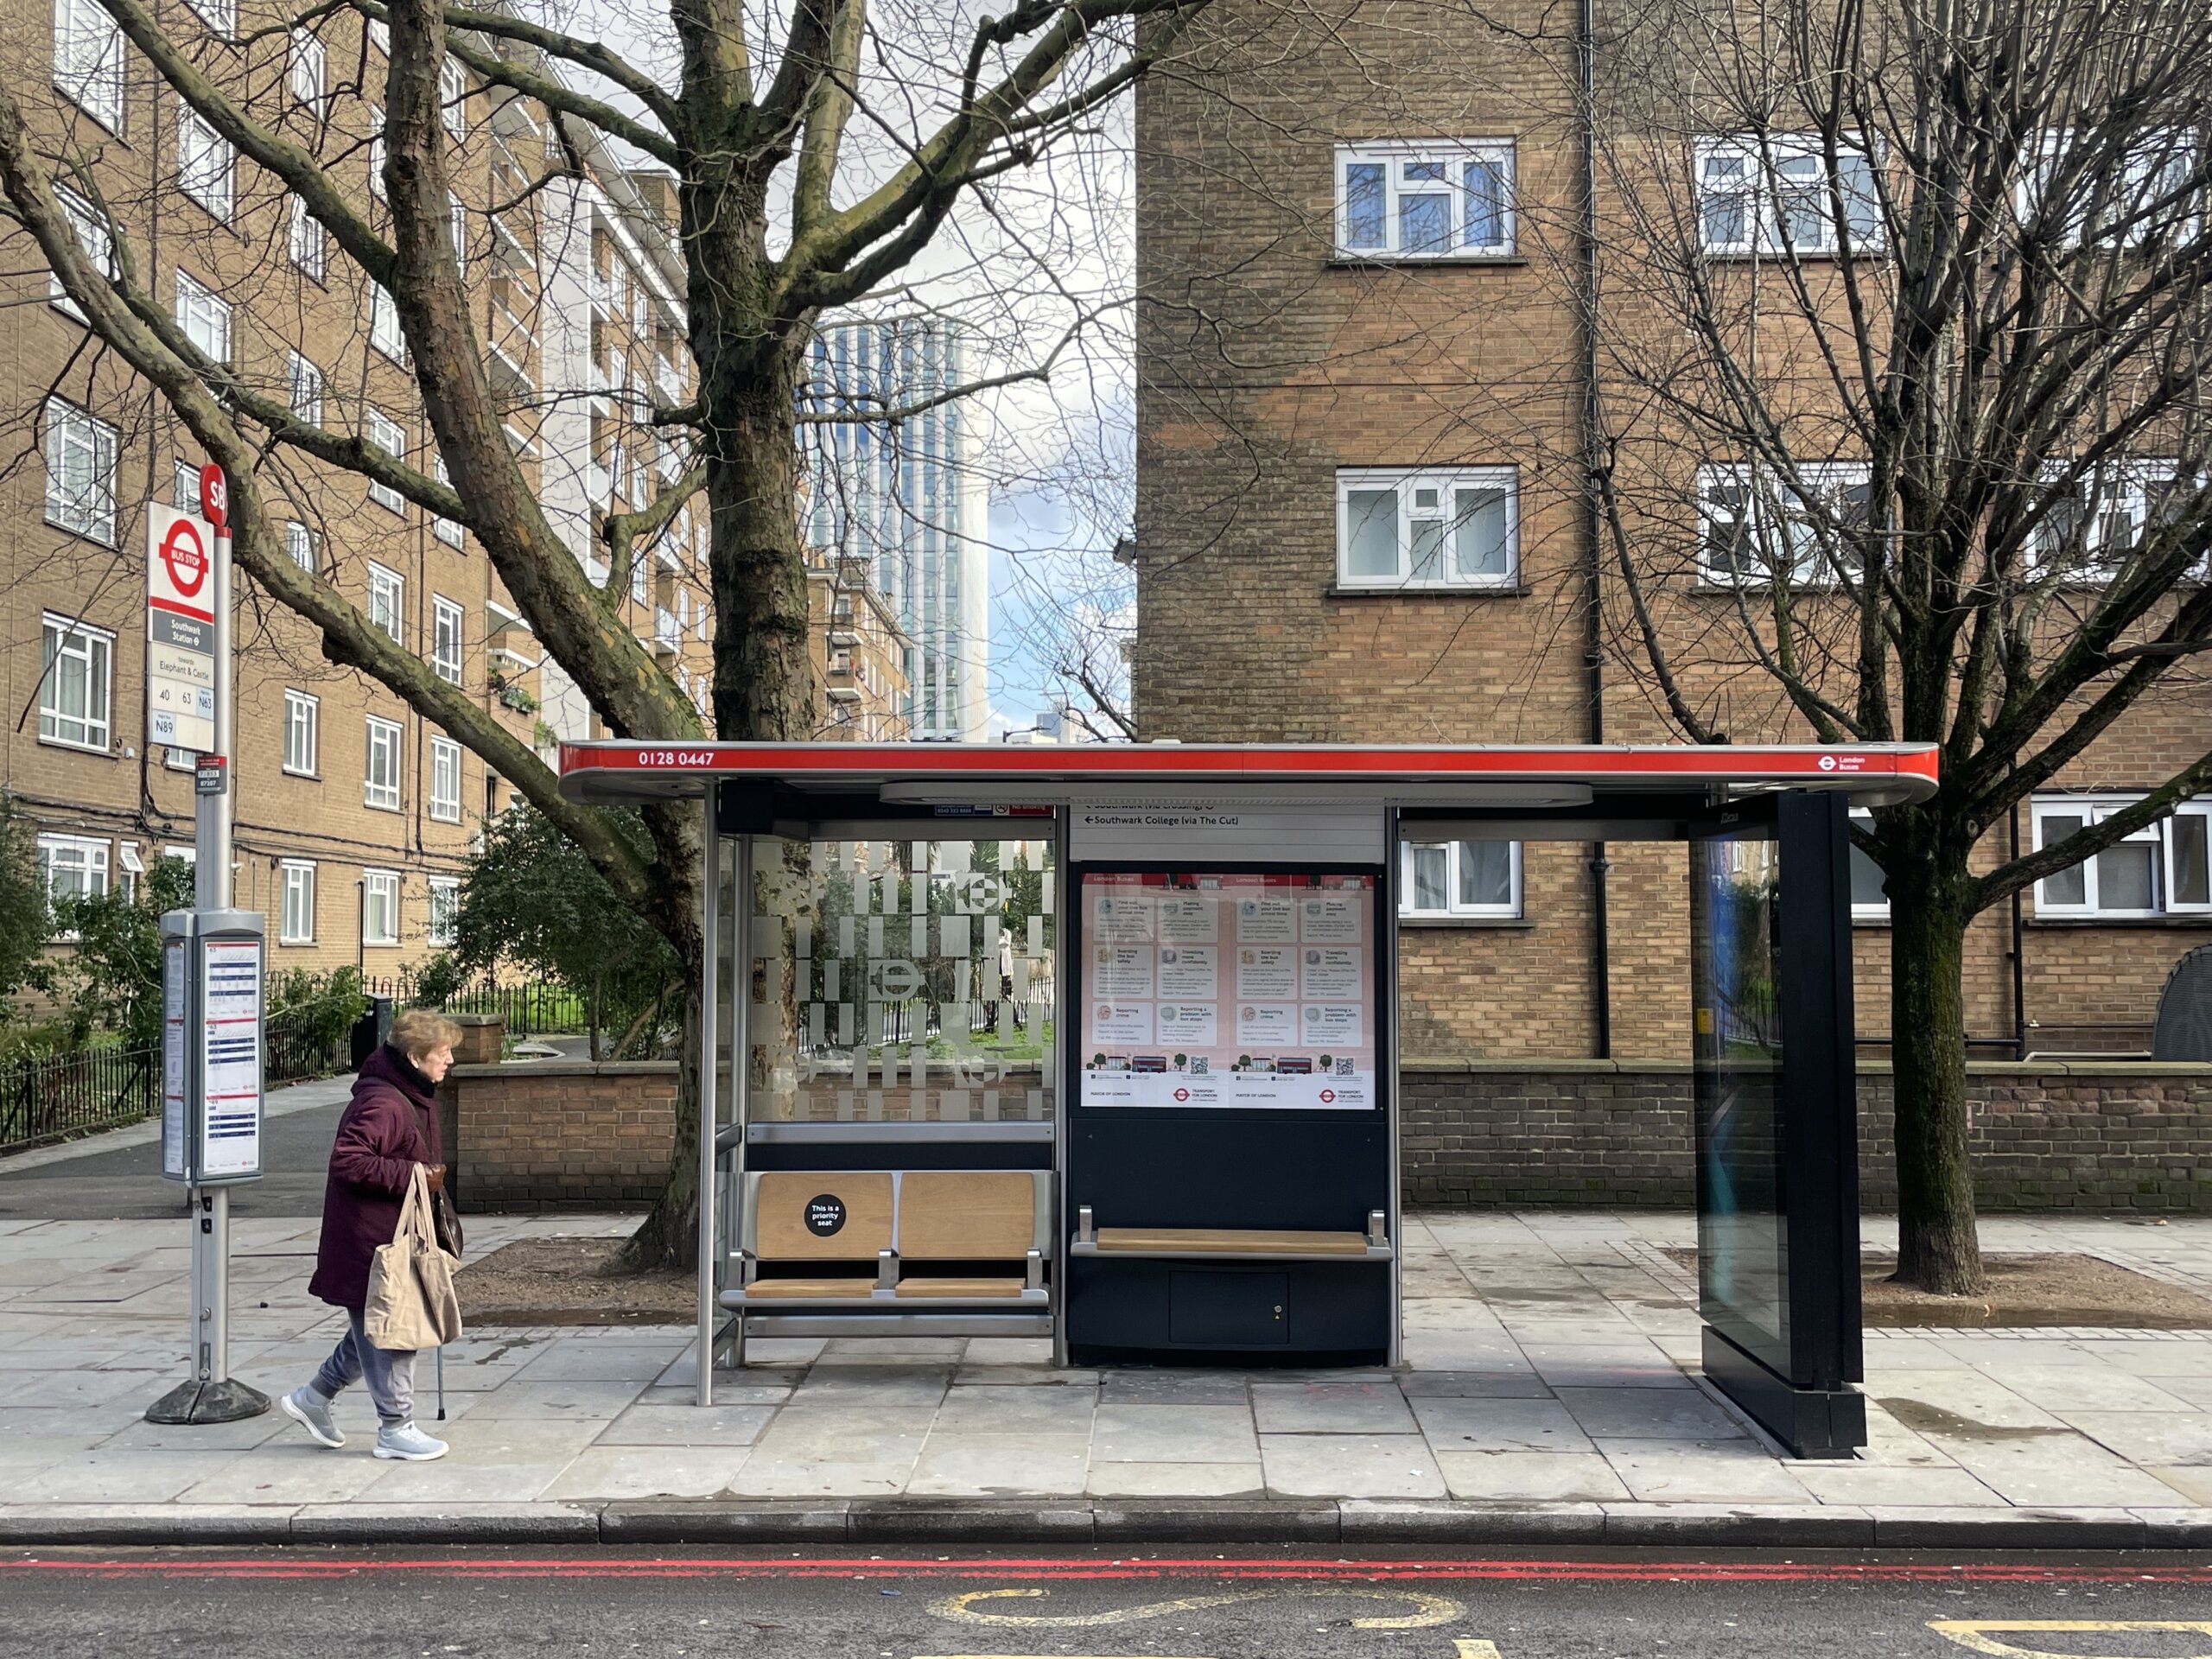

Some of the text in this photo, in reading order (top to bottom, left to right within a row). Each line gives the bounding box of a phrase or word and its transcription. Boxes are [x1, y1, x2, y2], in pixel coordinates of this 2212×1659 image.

[210, 480, 226, 511] SB
[171, 549, 200, 567] BUS STOP
[171, 619, 200, 635] Southwark
[173, 631, 193, 645] Station
[178, 657, 194, 665] towards
[160, 660, 209, 681] Elephant & Castle
[159, 689, 170, 701] 40
[182, 691, 192, 705] 63
[199, 696, 212, 709] N63
[156, 719, 173, 733] N89
[639, 752, 715, 766] 0128 0447
[1094, 816, 1142, 824] Southwark
[1145, 816, 1179, 826] College
[1181, 816, 1198, 825] (via
[1218, 816, 1238, 825] Cut)
